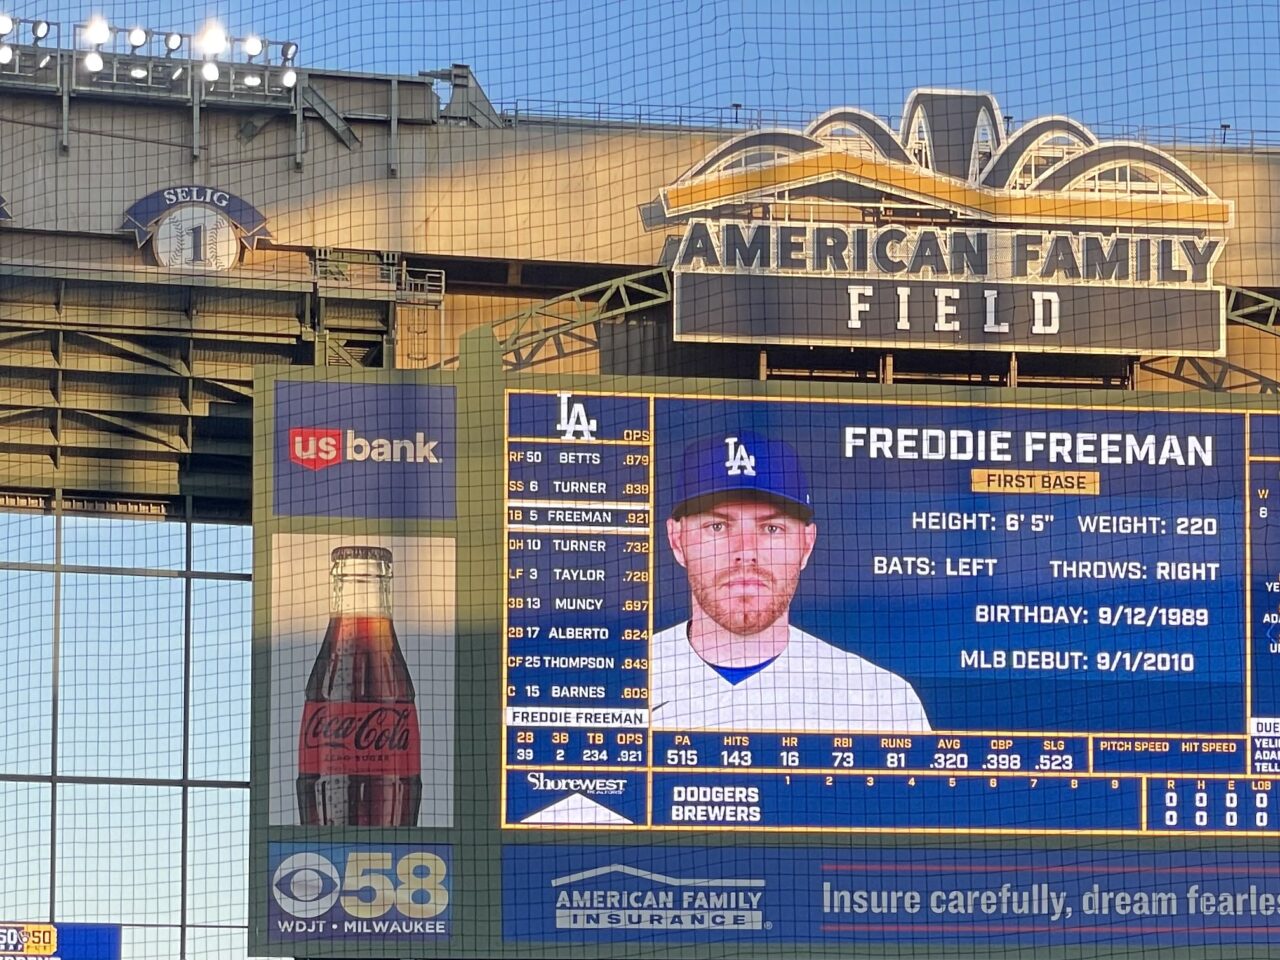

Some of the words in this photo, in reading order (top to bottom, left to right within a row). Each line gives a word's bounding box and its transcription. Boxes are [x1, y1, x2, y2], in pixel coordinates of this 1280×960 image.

[163, 187, 230, 207] SELIG
[185, 223, 212, 267] 1
[681, 223, 987, 276] AMERICAN
[1013, 234, 1224, 284] FAMILY
[847, 286, 1060, 335] FIELD
[556, 393, 597, 441] LA
[294, 436, 337, 460] us
[844, 427, 1012, 462] FREDDIE
[1025, 431, 1213, 467] FREEMAN
[559, 452, 600, 464] BETTS
[553, 481, 607, 494] TURNER
[986, 474, 1036, 489] FIRST
[1041, 475, 1086, 490] BASE
[547, 510, 612, 523] FREEMAN
[912, 512, 996, 531] HEIGHT:
[1078, 515, 1166, 534] WEIGHT:
[1176, 518, 1217, 536] 220
[553, 539, 606, 552] TURNER
[553, 569, 605, 581] TAYLOR
[874, 556, 936, 575] BATS:
[945, 558, 998, 577] LEFT
[1049, 560, 1147, 580] THROWS:
[1156, 562, 1220, 581] RIGHT
[555, 598, 604, 610] MUNCY
[975, 605, 1088, 625] BIRTHDAY:
[1098, 607, 1209, 627] 9/12/1989
[548, 627, 609, 640] ALBERTO
[543, 657, 614, 669] THOMPSON
[960, 650, 1007, 669] MLB
[1012, 651, 1088, 670] DEBUT:
[1096, 652, 1194, 672] 9/1/2010
[551, 686, 606, 698] BARNES
[512, 711, 572, 723] FREDDIE
[576, 712, 643, 724] FREEMAN
[304, 705, 411, 751] Coca-Cola
[1256, 722, 1280, 733] DUE
[1100, 741, 1132, 751] PITCH
[1134, 742, 1170, 752] SPEED
[1181, 742, 1200, 752] HIT
[1202, 743, 1237, 752] SPEED
[673, 786, 760, 802] DODGERS
[671, 806, 761, 822] BREWERS
[340, 852, 449, 919] 58
[556, 890, 674, 909] AMERICAN
[682, 891, 763, 910] FAMILY
[822, 881, 921, 914] Insure
[930, 882, 1072, 922] carefully,
[1082, 883, 1178, 916] dream
[277, 921, 327, 933] WDJT
[344, 920, 446, 933] MILWAUKEE
[571, 914, 747, 926] INSURANCE
[32, 930, 52, 944] 50
